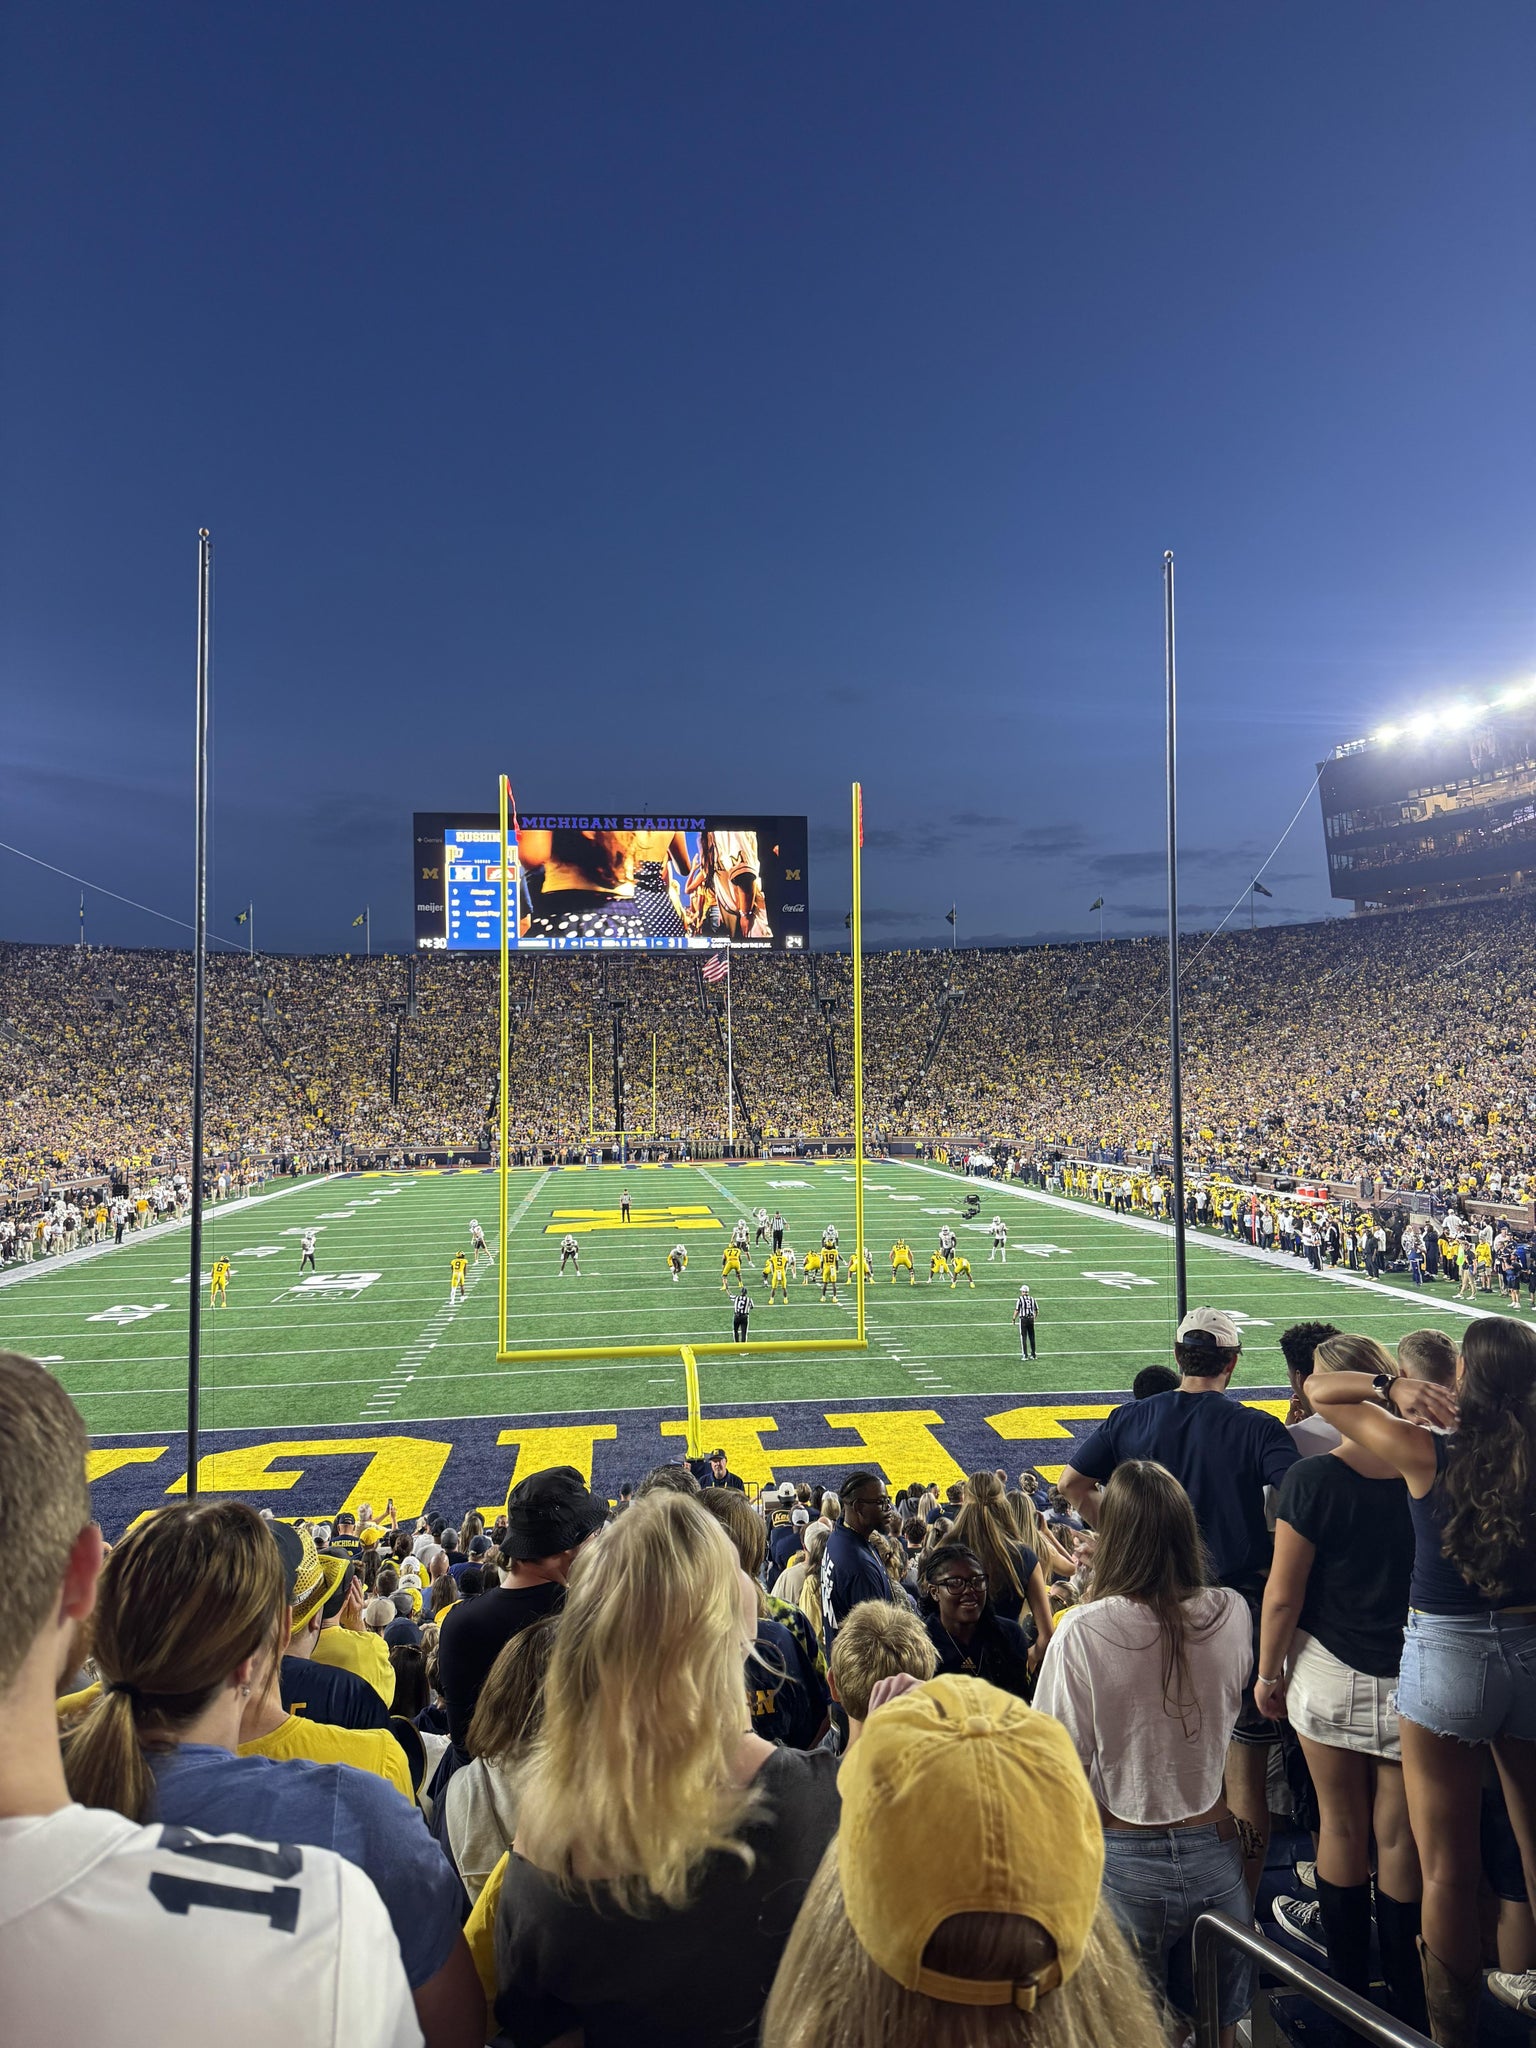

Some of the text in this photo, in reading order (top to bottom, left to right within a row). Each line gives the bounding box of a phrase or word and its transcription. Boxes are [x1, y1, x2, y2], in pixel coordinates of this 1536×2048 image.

[522, 817, 706, 830] MICHIGAN STADIUM
[456, 832, 501, 842] RUSHIN
[422, 868, 439, 879] M
[785, 869, 801, 880] M
[417, 902, 444, 913] meijer
[786, 937, 802, 948] 24
[776, 1257, 783, 1267] 5
[825, 1253, 834, 1263] 19
[331, 1541, 359, 1549] MICHIGAN
